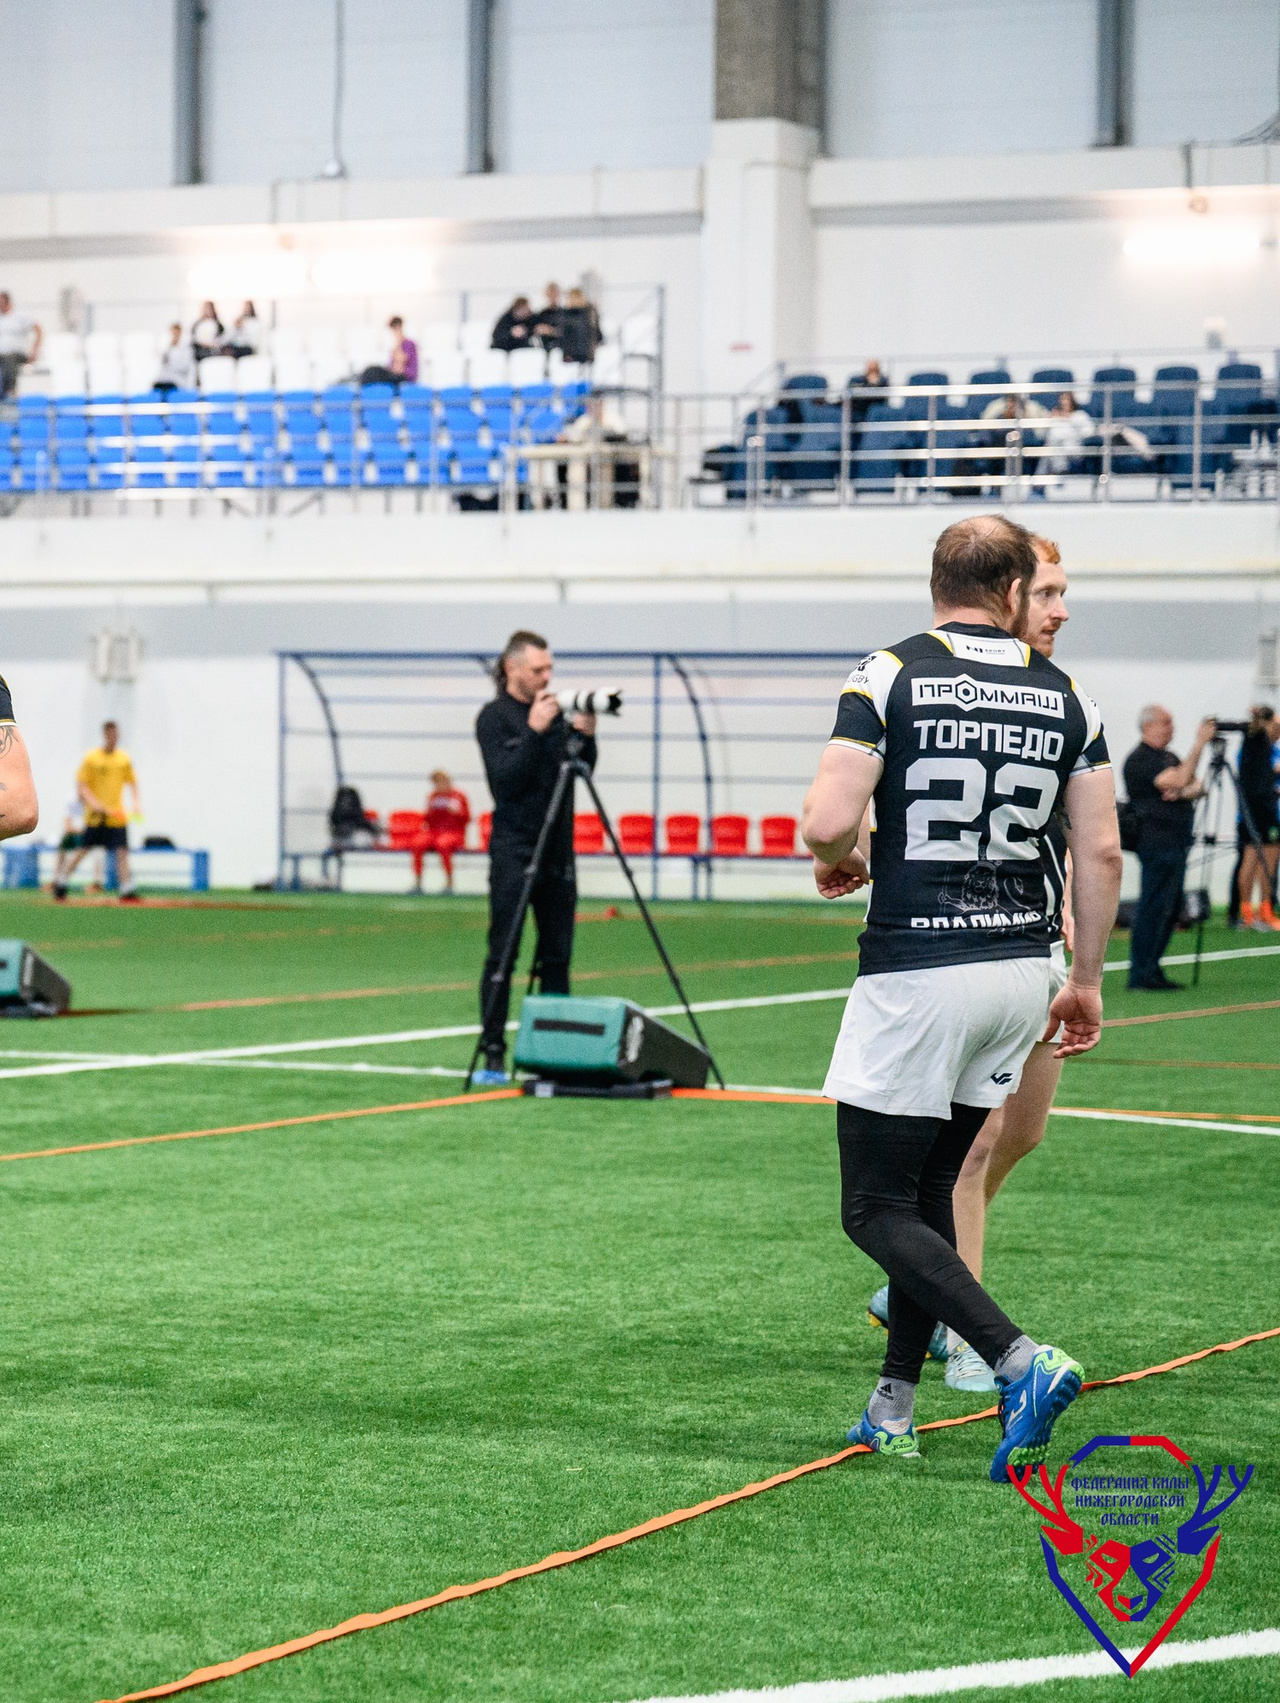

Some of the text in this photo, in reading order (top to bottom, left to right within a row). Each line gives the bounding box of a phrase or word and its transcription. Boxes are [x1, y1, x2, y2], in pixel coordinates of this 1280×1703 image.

[919, 680, 1059, 711] ПРОММАШ
[913, 719, 1065, 762] ТОРПЕДО
[904, 757, 1060, 862] 22
